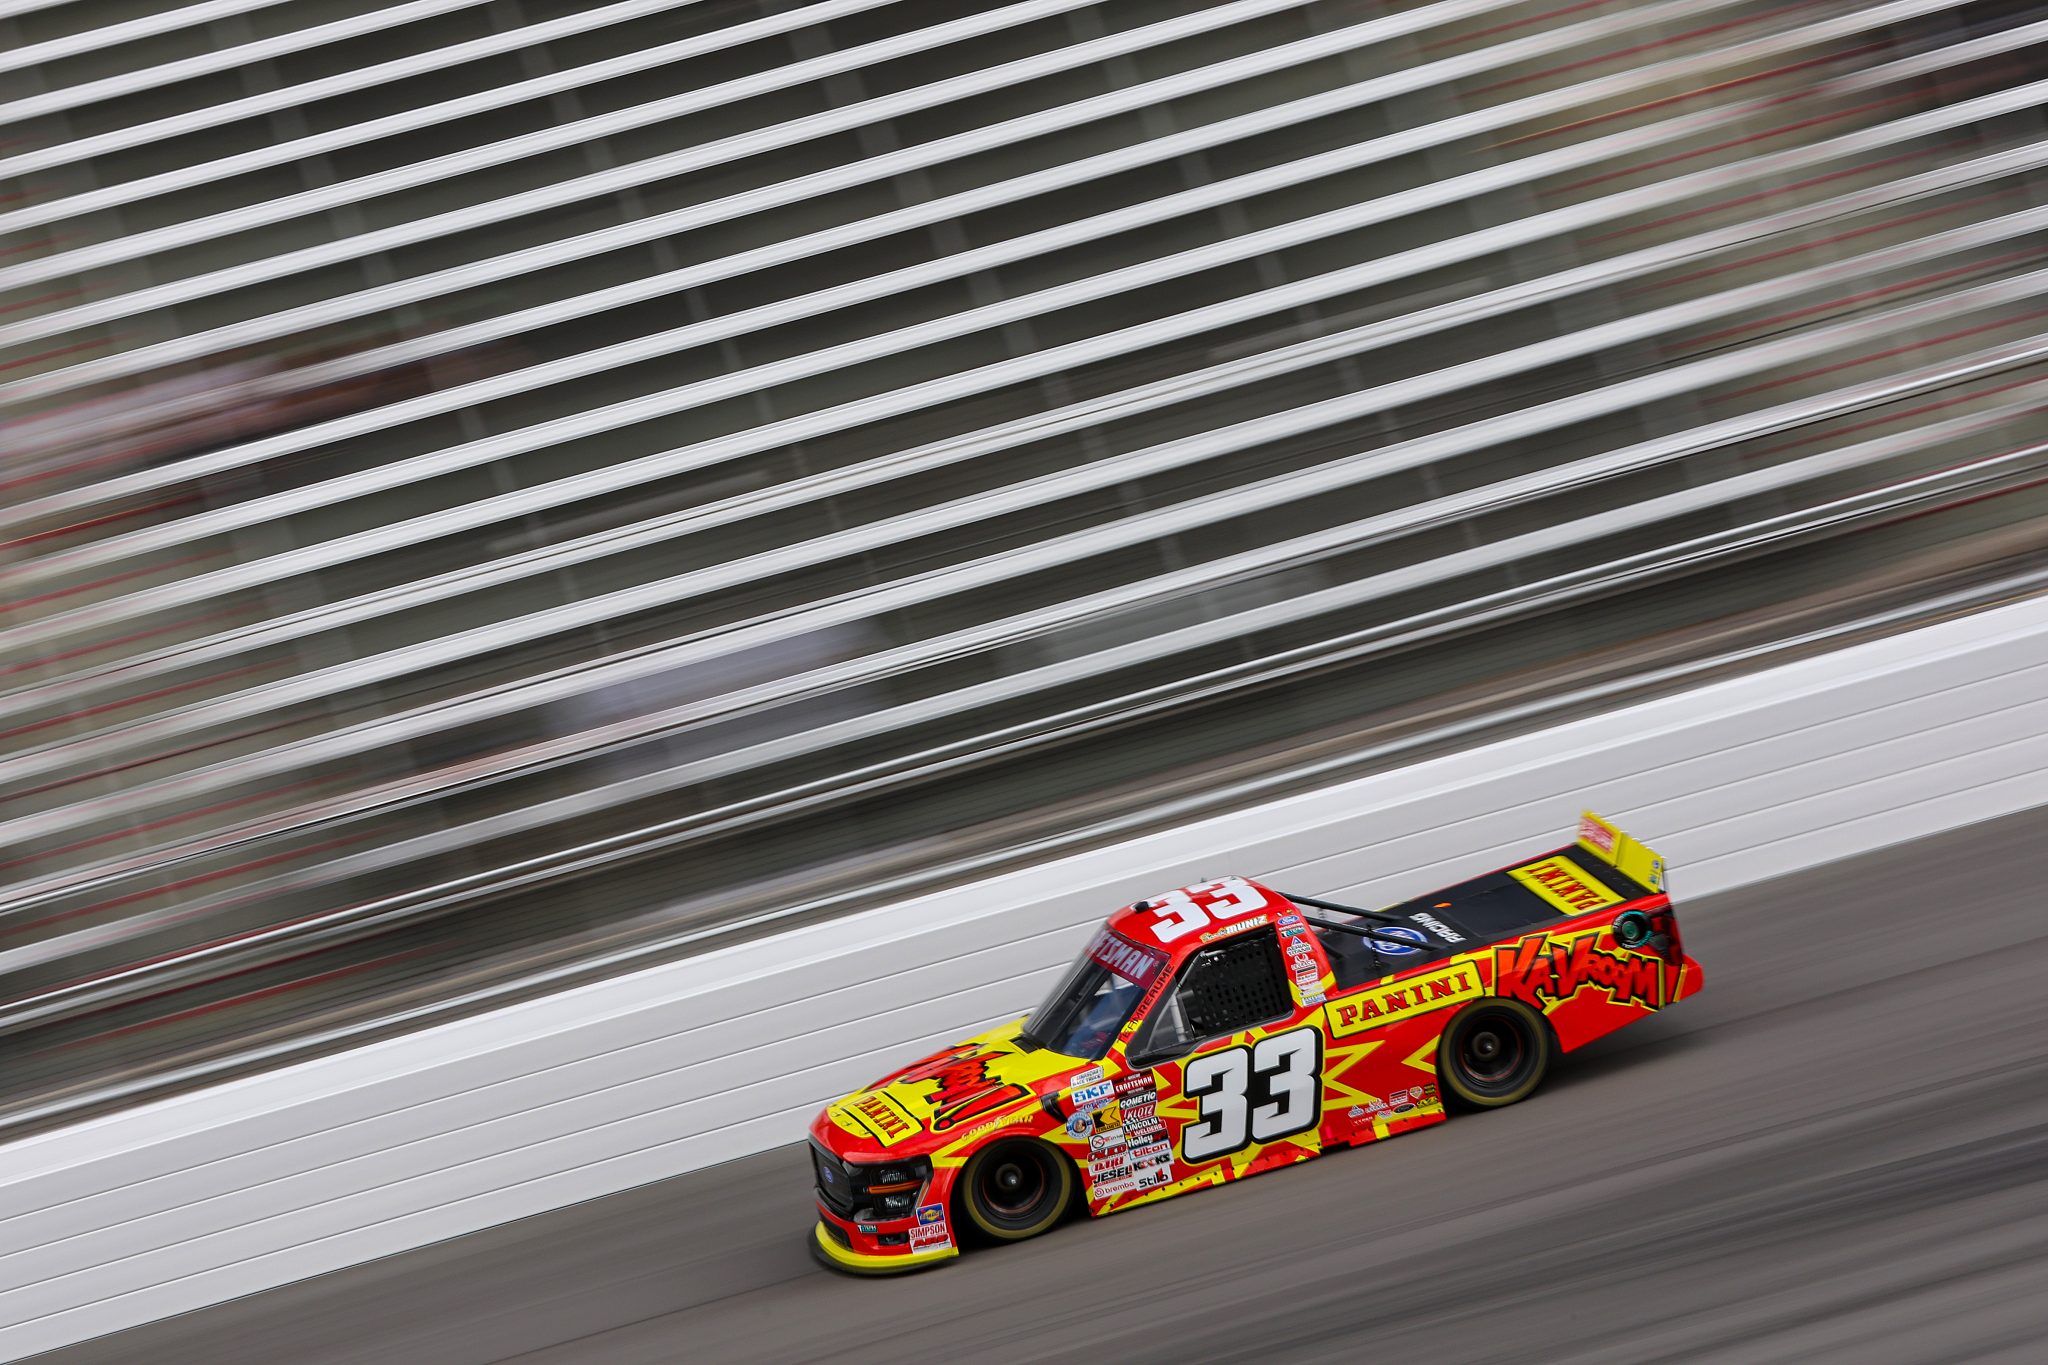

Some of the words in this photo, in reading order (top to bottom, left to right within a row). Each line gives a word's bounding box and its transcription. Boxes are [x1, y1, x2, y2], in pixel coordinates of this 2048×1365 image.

[1525, 862, 1609, 911] PANINI
[1129, 875, 1268, 943] 33
[1408, 912, 1467, 944] RACING
[1336, 971, 1472, 1027] PANINI
[1074, 1083, 1111, 1103] SKF
[1115, 1076, 1153, 1092] CRAFTSMAN
[1183, 1026, 1319, 1161] 33
[852, 1095, 911, 1139] PANINI
[1126, 1104, 1154, 1119] KLOTZ
[1125, 1117, 1158, 1132] LINCOLN
[1133, 1124, 1163, 1137] WELDERS
[1128, 1134, 1154, 1148] Holley
[1132, 1143, 1169, 1157] tilton
[1093, 1164, 1133, 1185] JESEL
[1104, 1181, 1135, 1194] brembo
[910, 1223, 946, 1240] SIMPSON
